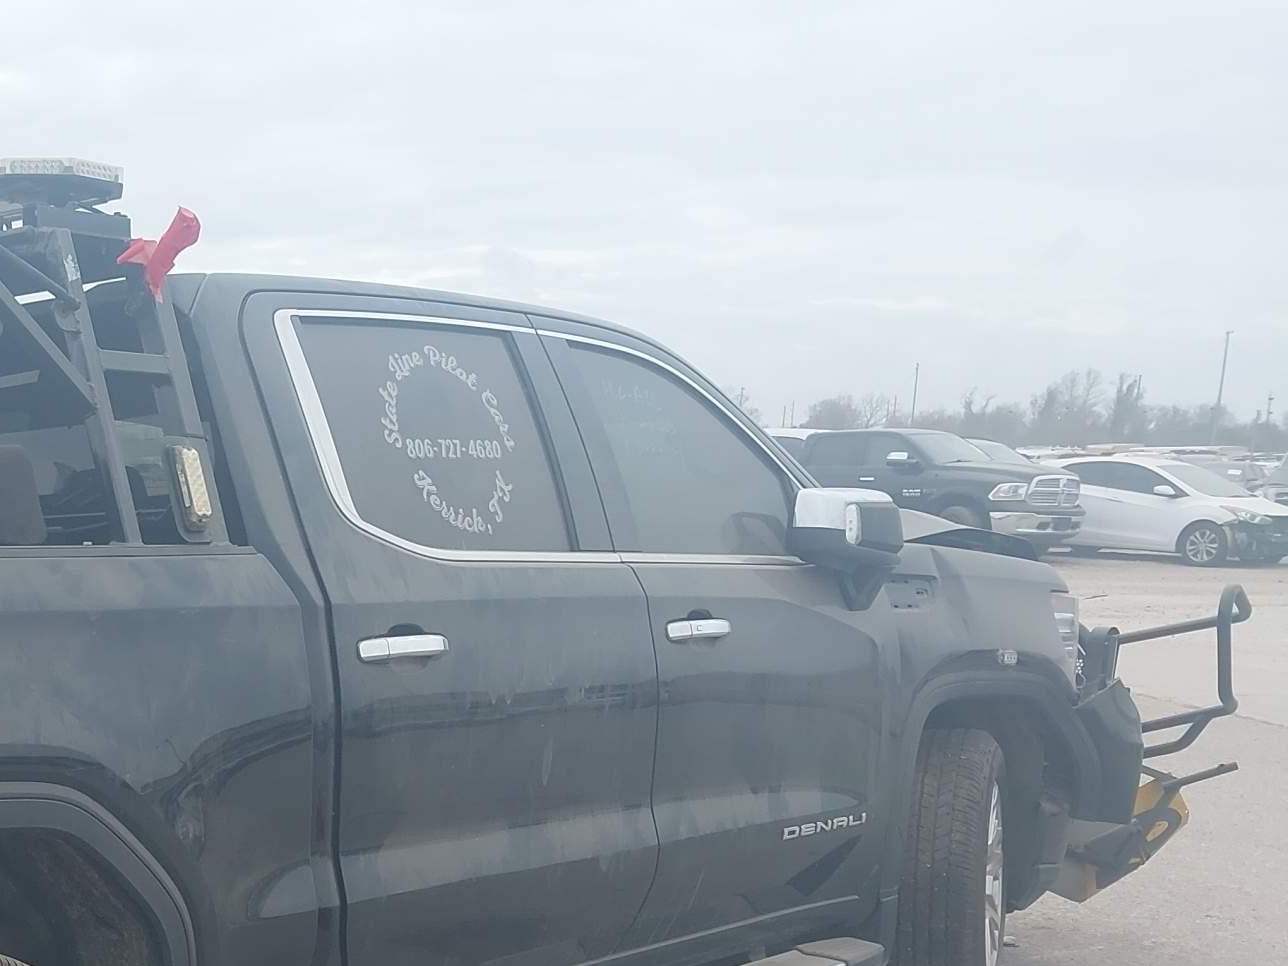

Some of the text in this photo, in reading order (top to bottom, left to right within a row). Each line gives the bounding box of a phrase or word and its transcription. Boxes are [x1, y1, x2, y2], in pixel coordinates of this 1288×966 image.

[379, 345, 515, 452] State Line Pilot Cars
[407, 438, 502, 459] 806-727-4680
[782, 812, 867, 841] DENALI
